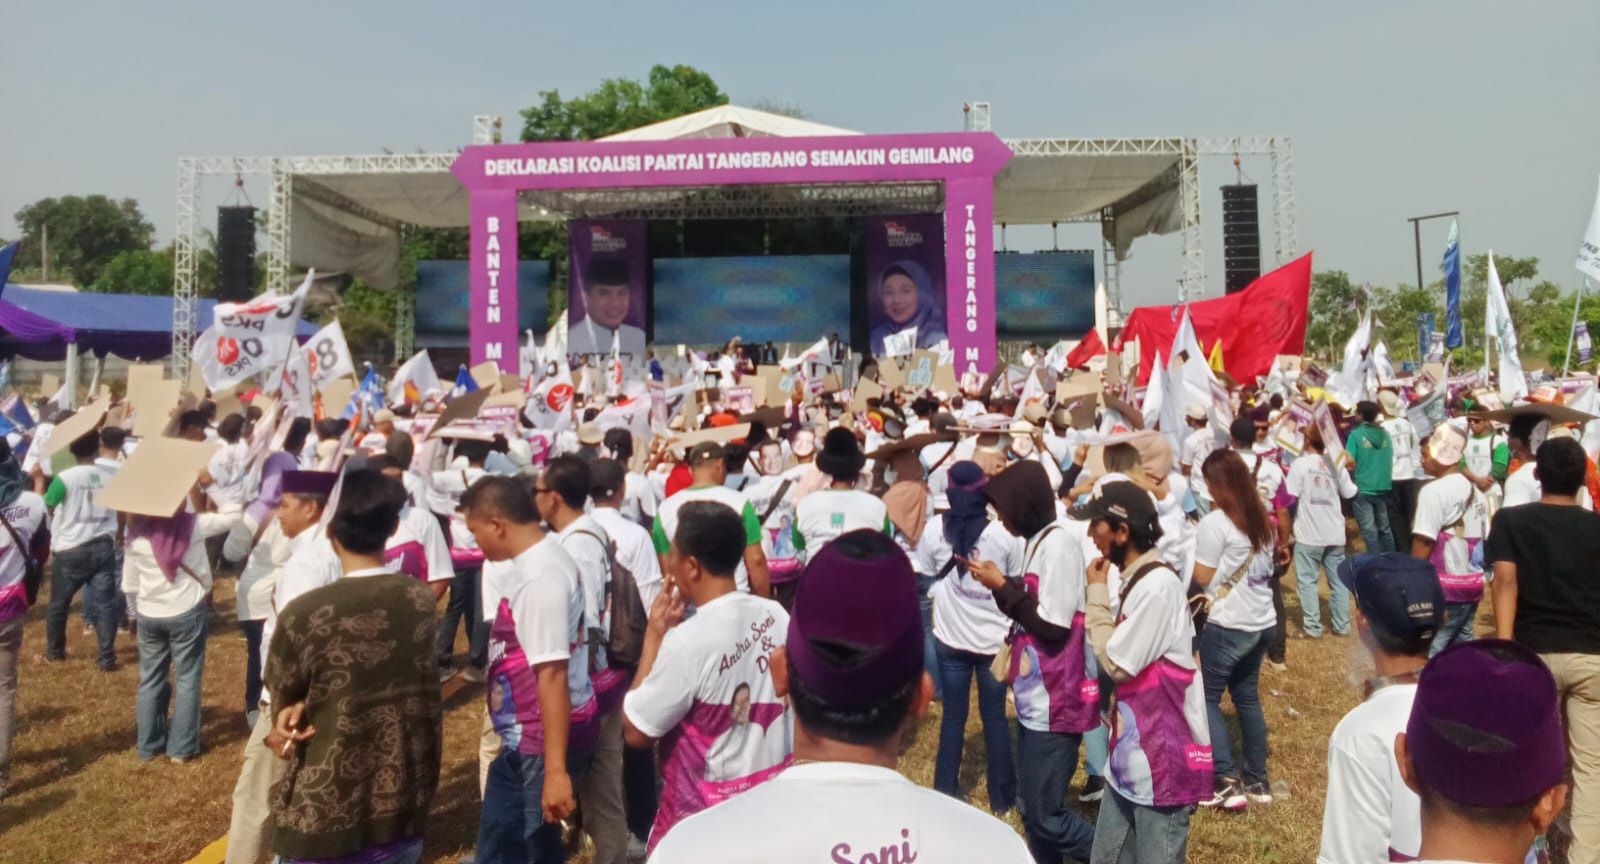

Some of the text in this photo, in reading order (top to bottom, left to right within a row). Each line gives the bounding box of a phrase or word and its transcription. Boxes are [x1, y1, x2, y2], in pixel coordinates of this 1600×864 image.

[485, 147, 974, 176] DEKLARASI KOALISI PARTAI TANGERANG SEMAKIN GEMILANG
[486, 216, 500, 323] BANTEN
[965, 205, 977, 332] TANGERANG
[718, 611, 775, 676] Andra Soni
[761, 636, 776, 651] &
[830, 828, 918, 864] Soni
